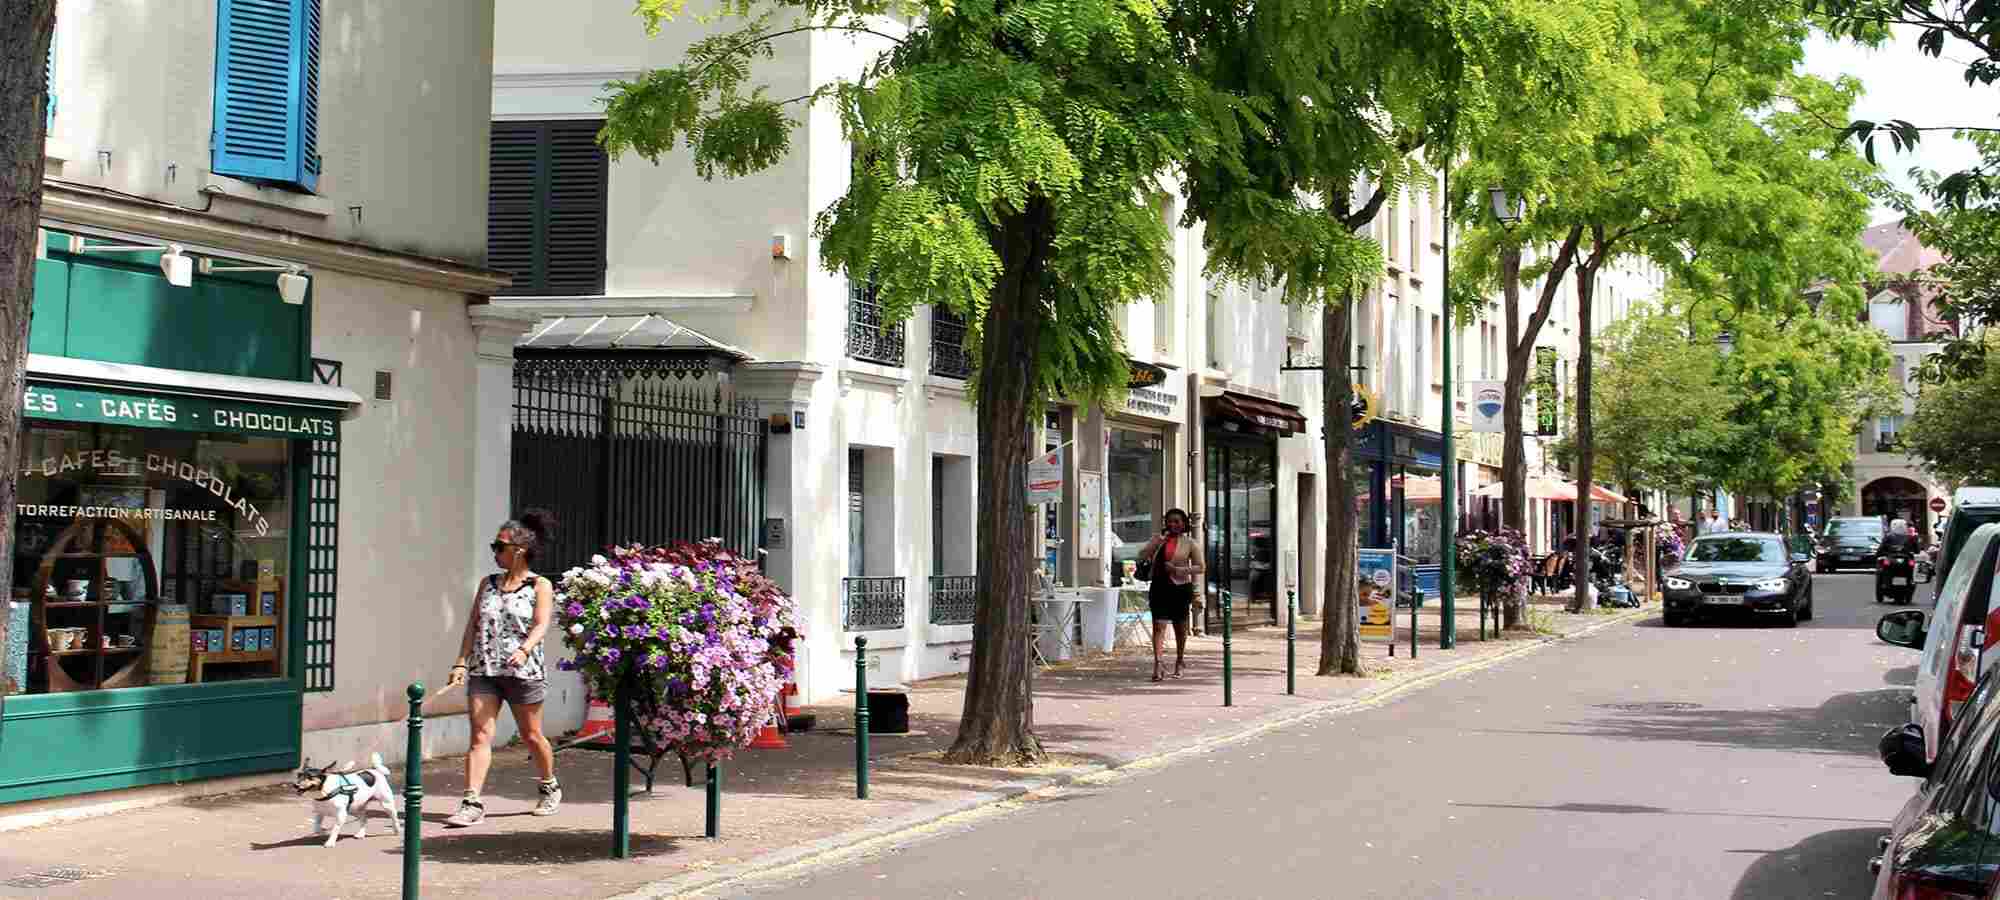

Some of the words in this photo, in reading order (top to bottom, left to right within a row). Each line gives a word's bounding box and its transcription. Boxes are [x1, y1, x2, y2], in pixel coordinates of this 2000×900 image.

[24, 386, 57, 412] ÉS
[102, 398, 176, 422] CAFÉS
[213, 410, 334, 436] CHOCOLATS
[16, 503, 129, 519] TORREFACTION
[134, 508, 217, 522] ARTISANALE
[146, 453, 270, 537] CHOCOLATS
